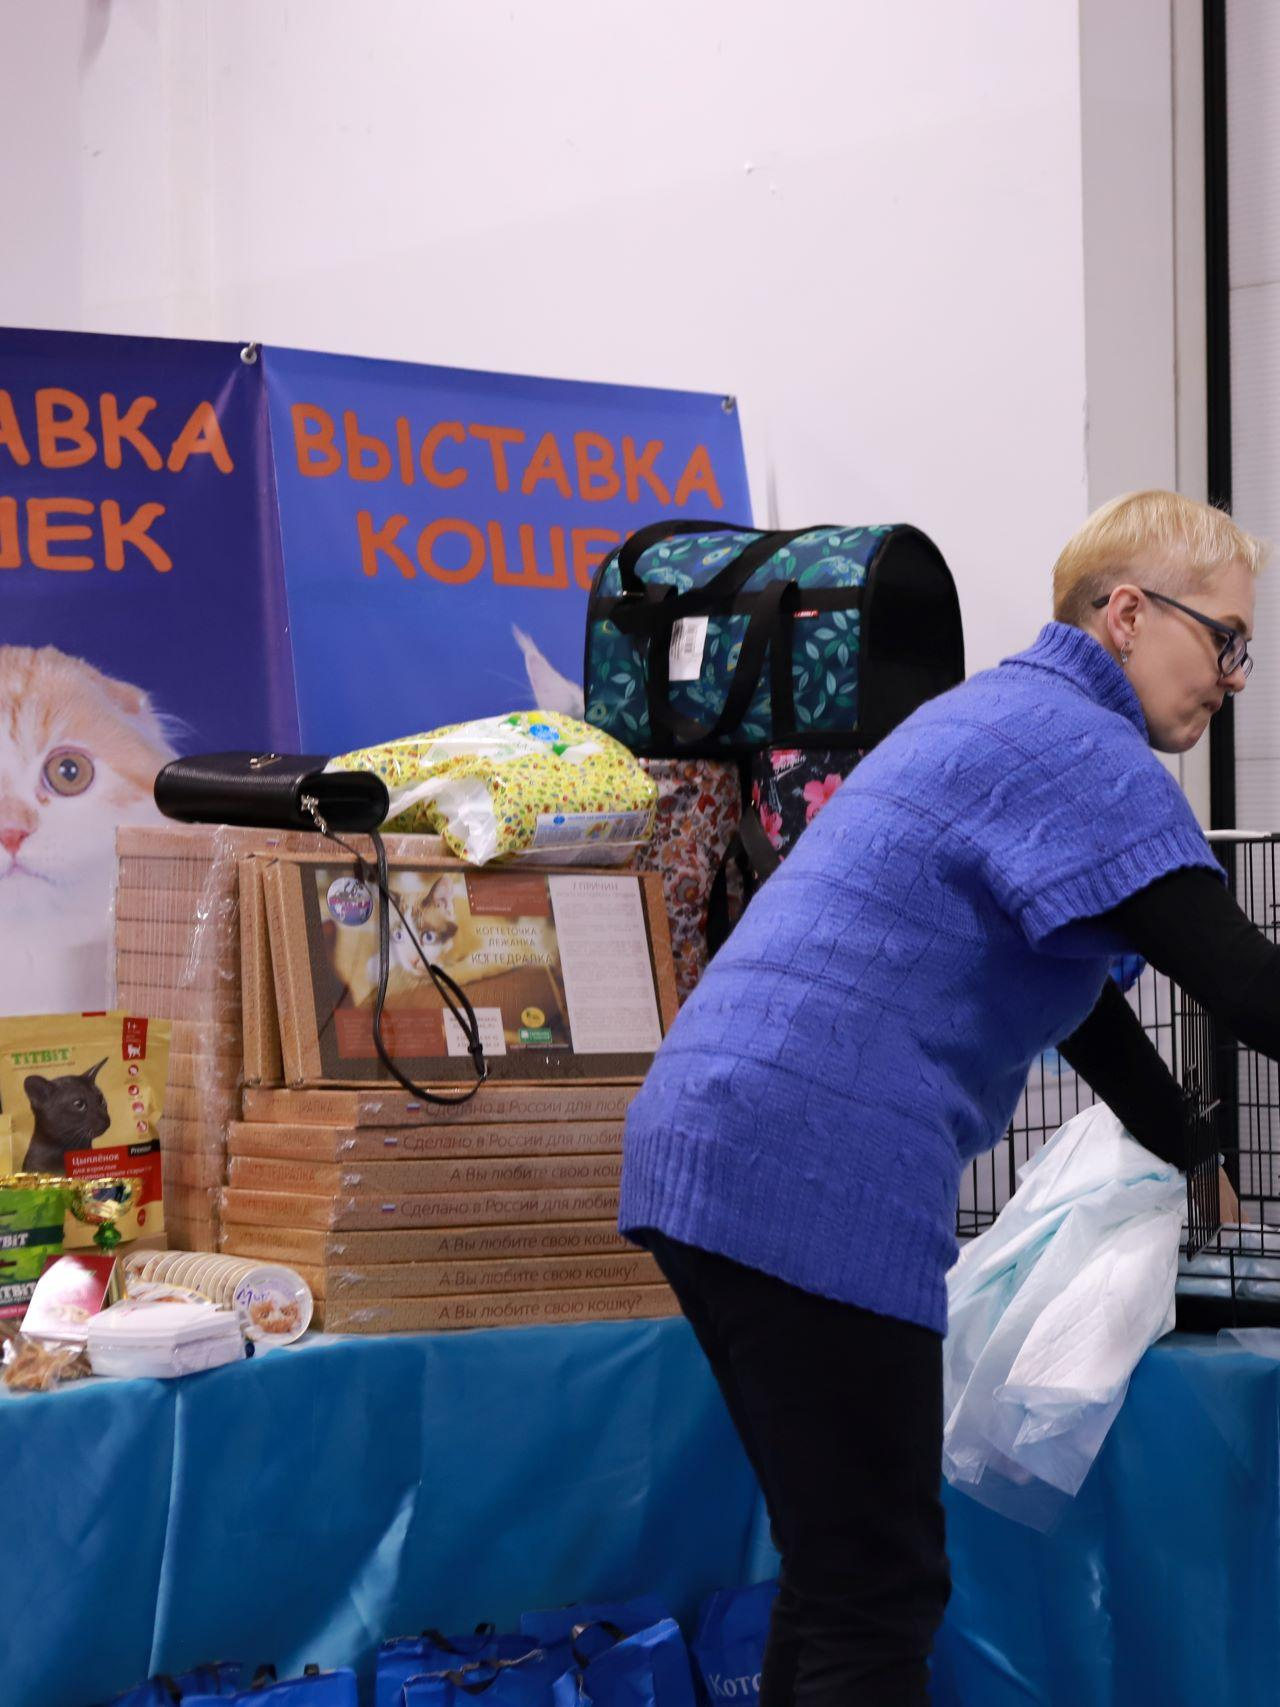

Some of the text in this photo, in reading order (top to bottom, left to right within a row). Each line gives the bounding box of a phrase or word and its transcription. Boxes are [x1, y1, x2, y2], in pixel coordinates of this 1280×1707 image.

[291, 403, 723, 509] ВЫСТАВКА
[357, 510, 674, 590] КОШЕ
[509, 1099, 561, 1114] России
[565, 1099, 593, 1114] для
[596, 1096, 629, 1112] люб
[403, 1134, 472, 1152] Сделано
[489, 1132, 543, 1148] России
[545, 1133, 574, 1148] для
[577, 1129, 623, 1145] люби
[449, 1164, 623, 1183] А Вы любите свою кош
[400, 1200, 469, 1219] Сделано
[472, 1202, 481, 1214] в
[485, 1199, 540, 1214] России
[541, 1199, 570, 1215] для
[0, 1232, 29, 1249] BiT
[437, 1237, 450, 1253] А
[453, 1236, 476, 1252] Вы
[479, 1234, 538, 1251] любите
[541, 1234, 581, 1249] свою
[438, 1262, 640, 1287] А Вы любите свою кошку?
[438, 1294, 643, 1320] А Вы любите свою кошку?
